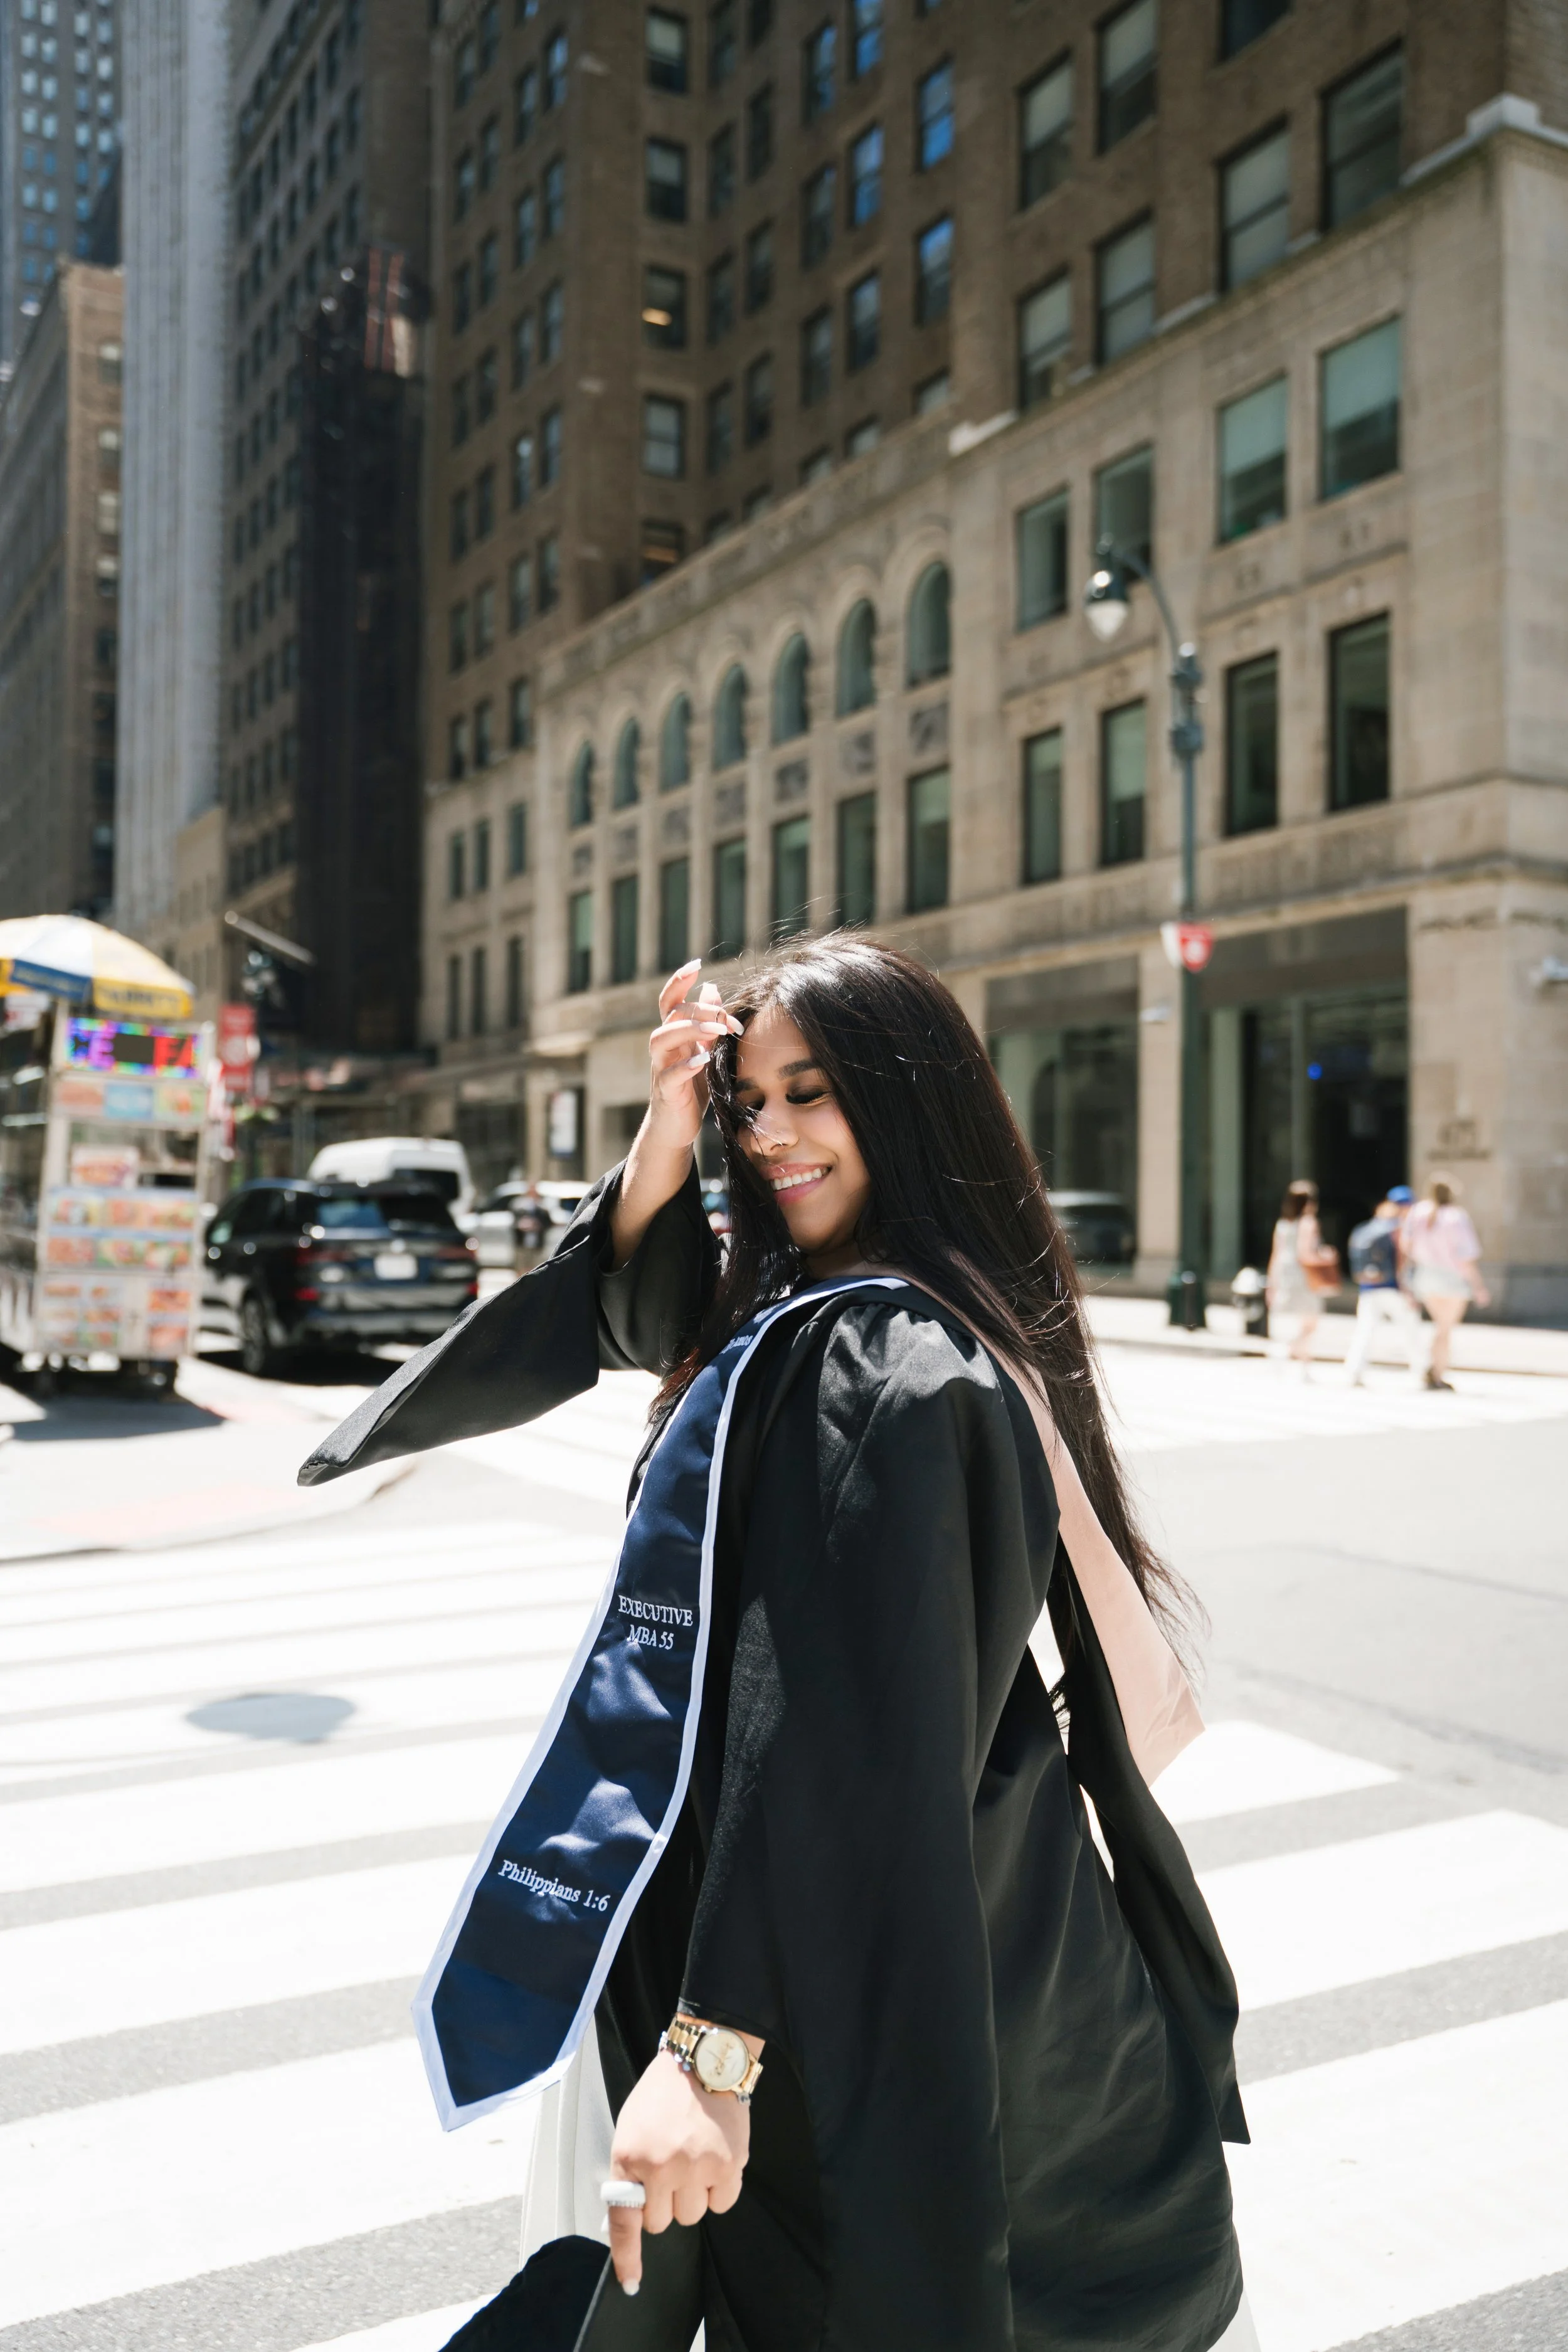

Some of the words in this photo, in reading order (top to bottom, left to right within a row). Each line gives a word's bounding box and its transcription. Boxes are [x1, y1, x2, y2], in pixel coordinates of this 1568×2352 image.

[618, 1595, 693, 1626] EXECUTIVE
[627, 1624, 657, 1647] MBA
[659, 1631, 674, 1650] 55
[498, 1860, 581, 1902] Philippians
[583, 1890, 611, 1912] 1:6
